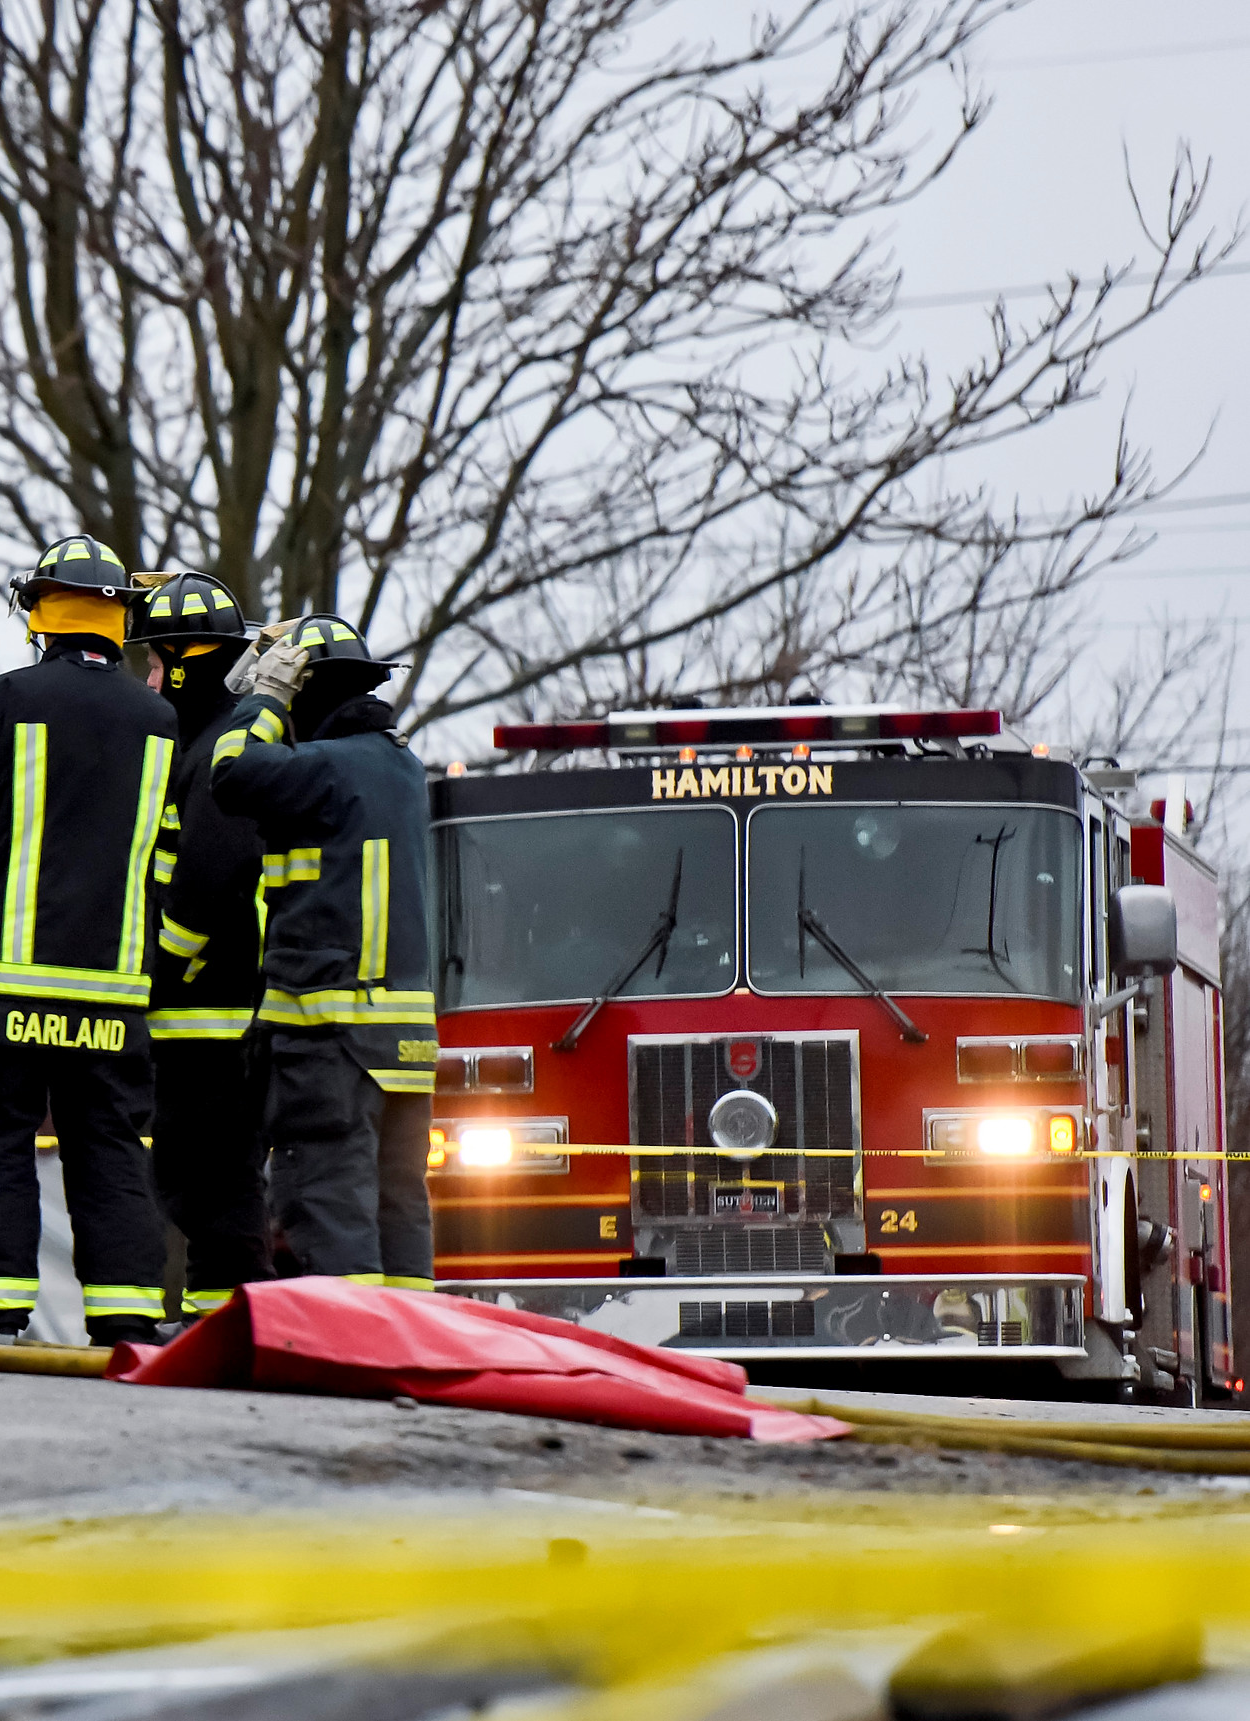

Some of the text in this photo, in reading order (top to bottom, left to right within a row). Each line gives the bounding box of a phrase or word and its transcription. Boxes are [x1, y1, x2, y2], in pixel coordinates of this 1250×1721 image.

[652, 764, 833, 799] HAMILTON
[6, 1010, 126, 1052] GARLAND
[717, 1195, 776, 1206] SUTHEN
[600, 1216, 618, 1240] E
[880, 1210, 918, 1234] 24
